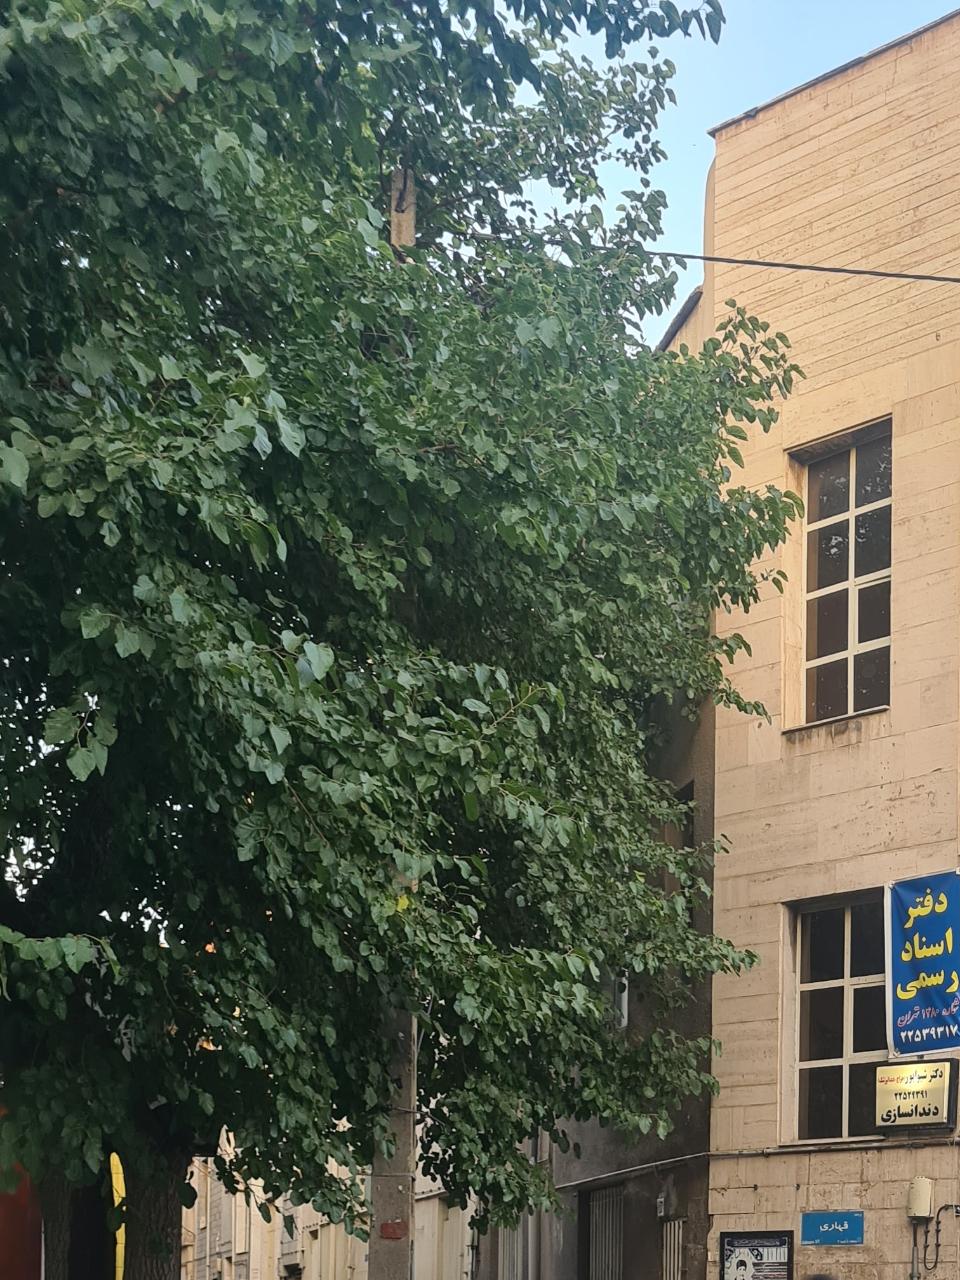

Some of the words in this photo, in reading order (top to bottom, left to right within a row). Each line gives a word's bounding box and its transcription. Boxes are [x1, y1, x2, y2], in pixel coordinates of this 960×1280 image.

[903, 887, 948, 929] دفتر
[901, 926, 953, 962] اسناد
[896, 969, 960, 1000] رسمی
[896, 1005, 920, 1028] تهران
[900, 1023, 959, 1043] ۲۲۵۳۹۳۱۷
[928, 1067, 944, 1083] دکتر
[880, 1103, 940, 1124] دندانسازی
[819, 1220, 849, 1232] قهاری
